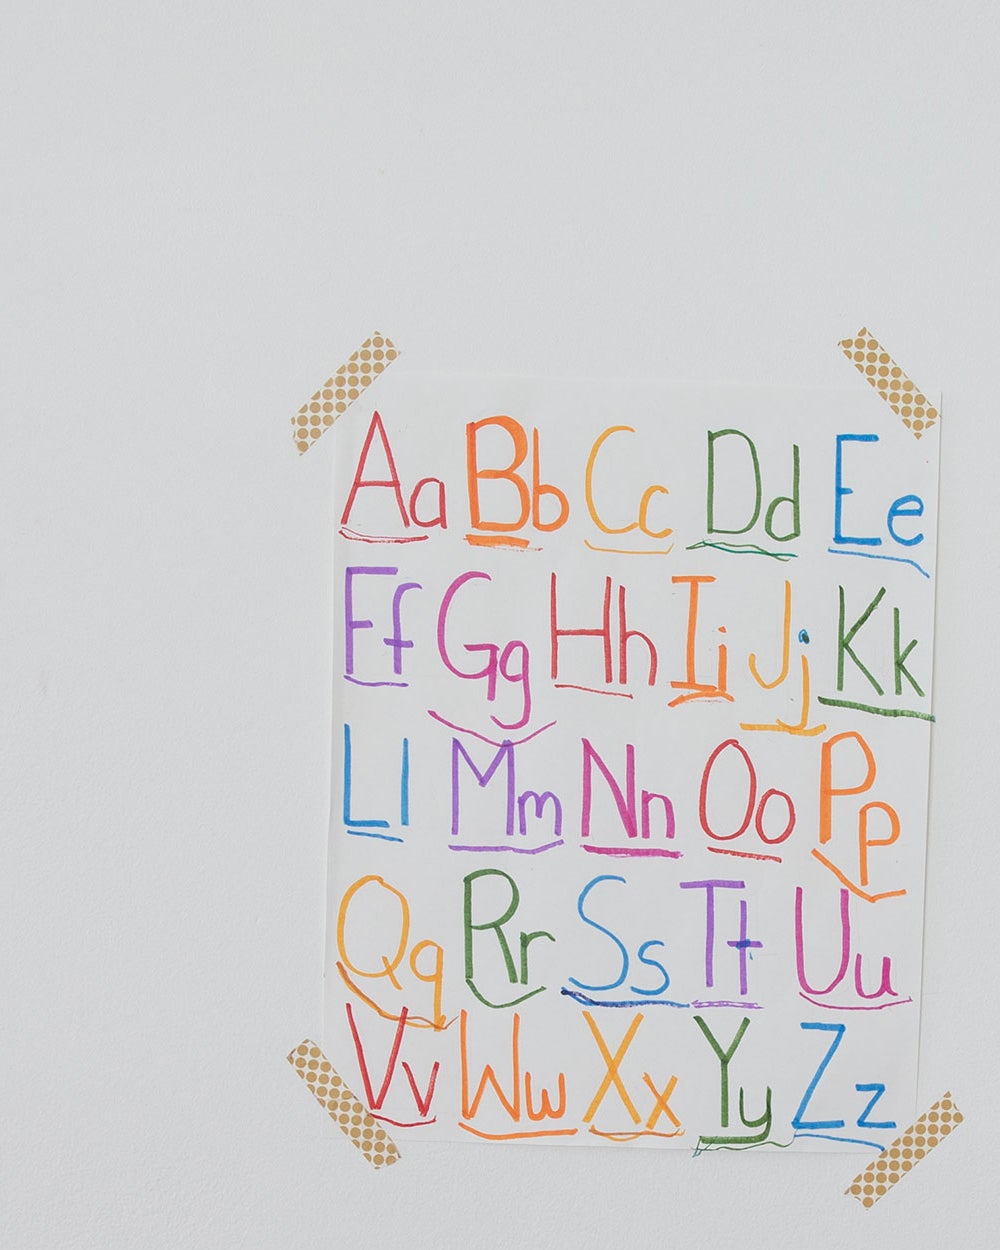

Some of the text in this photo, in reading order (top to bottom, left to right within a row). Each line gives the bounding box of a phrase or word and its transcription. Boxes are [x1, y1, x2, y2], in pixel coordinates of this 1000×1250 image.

[341, 411, 924, 546] Aa Bb Cc Dd Ee
[345, 566, 925, 735] Ff Gg Hh Ii Jj Kk
[344, 724, 900, 886] Ll Mm Nn Oo Pp
[337, 869, 899, 1030] Qq Rr Ss Tt Uu
[346, 1003, 897, 1144] Vv Ww Xx Yy Zz
